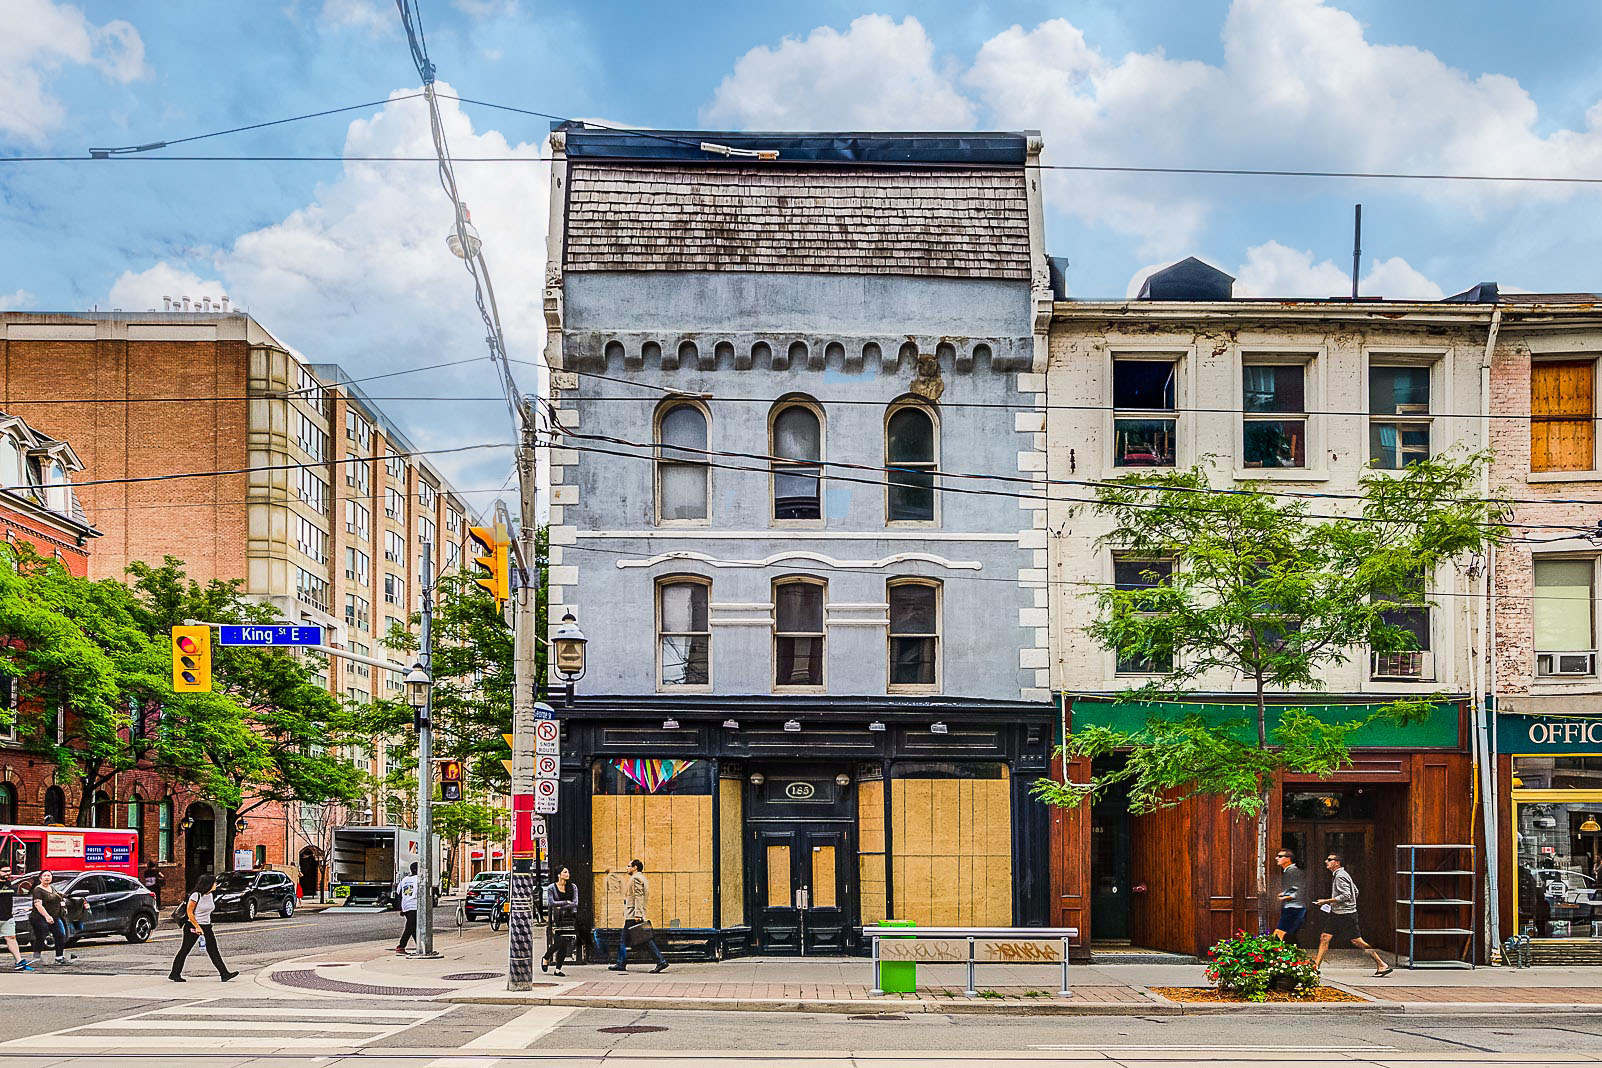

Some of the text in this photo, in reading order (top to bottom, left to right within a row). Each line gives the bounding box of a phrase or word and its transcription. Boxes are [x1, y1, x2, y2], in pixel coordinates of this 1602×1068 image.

[242, 627, 300, 644] King St E
[1528, 722, 1602, 744] OFFIC
[791, 786, 810, 795] 185
